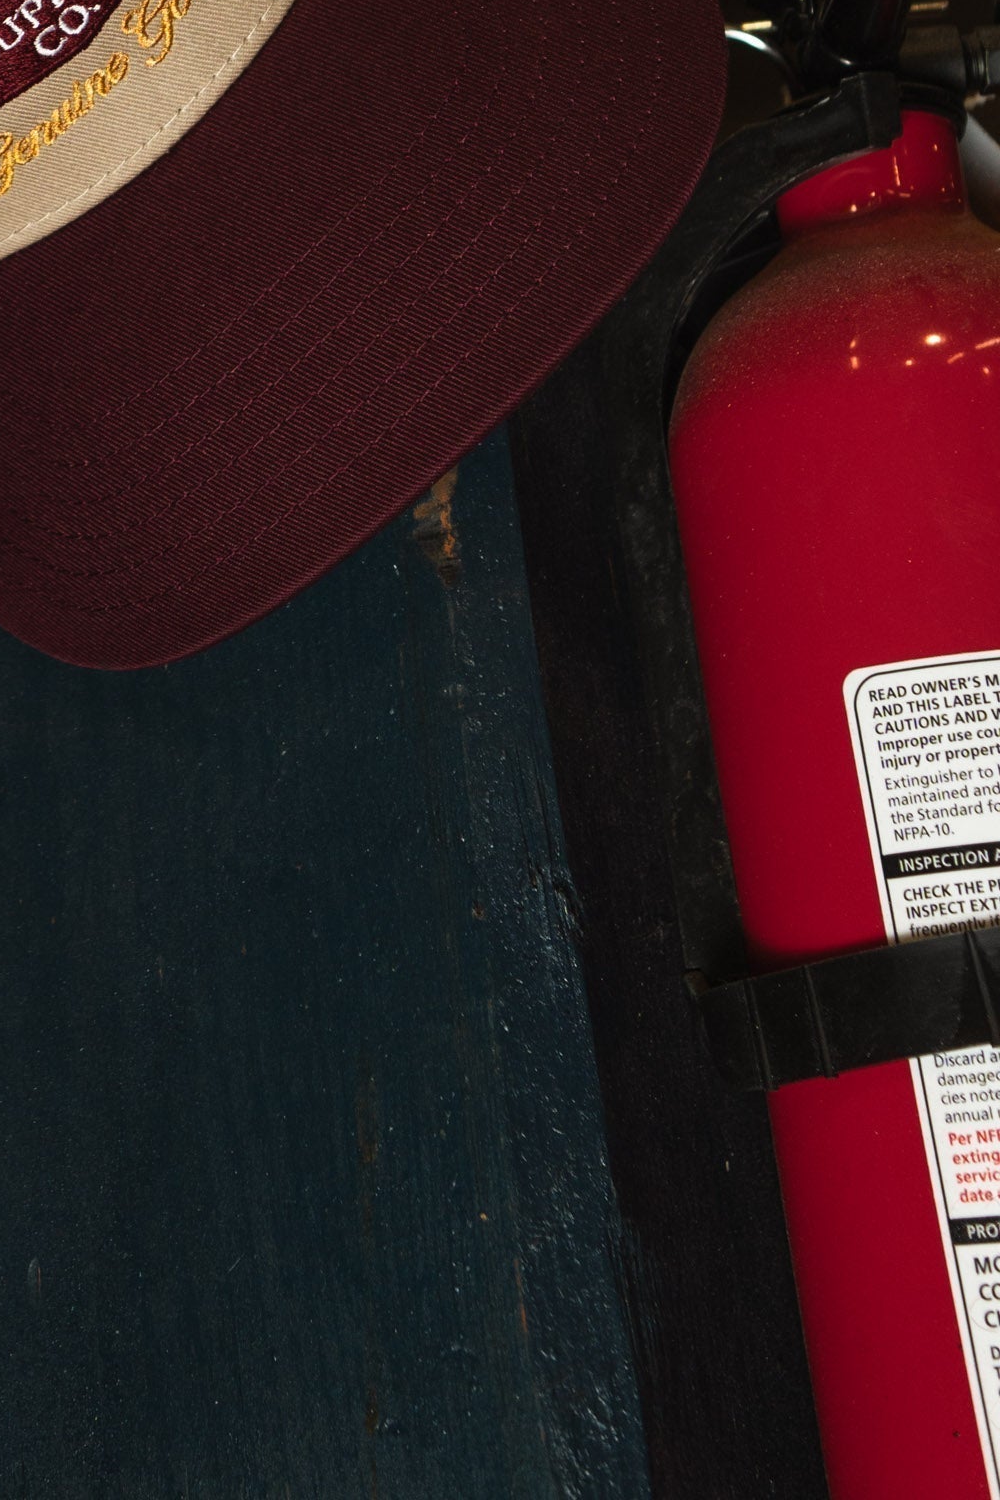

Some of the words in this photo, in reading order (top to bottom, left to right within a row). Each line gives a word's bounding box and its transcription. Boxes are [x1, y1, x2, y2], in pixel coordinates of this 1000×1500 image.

[34, 3, 102, 57] CO.
[869, 685, 907, 702] READ
[911, 676, 981, 696] OWNER'S
[873, 702, 903, 718] AND
[907, 698, 940, 713] THIS
[944, 694, 991, 709] LABEL
[874, 714, 950, 735] CAUTIONS
[955, 710, 988, 724] AND
[877, 733, 943, 752] Improper
[947, 730, 973, 743] use
[881, 752, 922, 769] injury
[926, 752, 941, 762] or
[885, 769, 973, 791] Extinguisher
[978, 767, 993, 780] to
[888, 785, 969, 808] maintained
[891, 810, 913, 825] the
[917, 802, 983, 822] Standard
[894, 824, 955, 842] NFPA-10.
[899, 849, 989, 872] INSPECTION
[903, 884, 951, 902] CHECK
[955, 880, 984, 895] THE
[906, 902, 965, 919] INSPECT
[910, 916, 986, 937] frequently
[934, 1050, 986, 1068] Discard
[940, 1090, 966, 1105] cies
[944, 1108, 994, 1124] annual
[948, 1131, 972, 1146] Per
[960, 1185, 993, 1203] date
